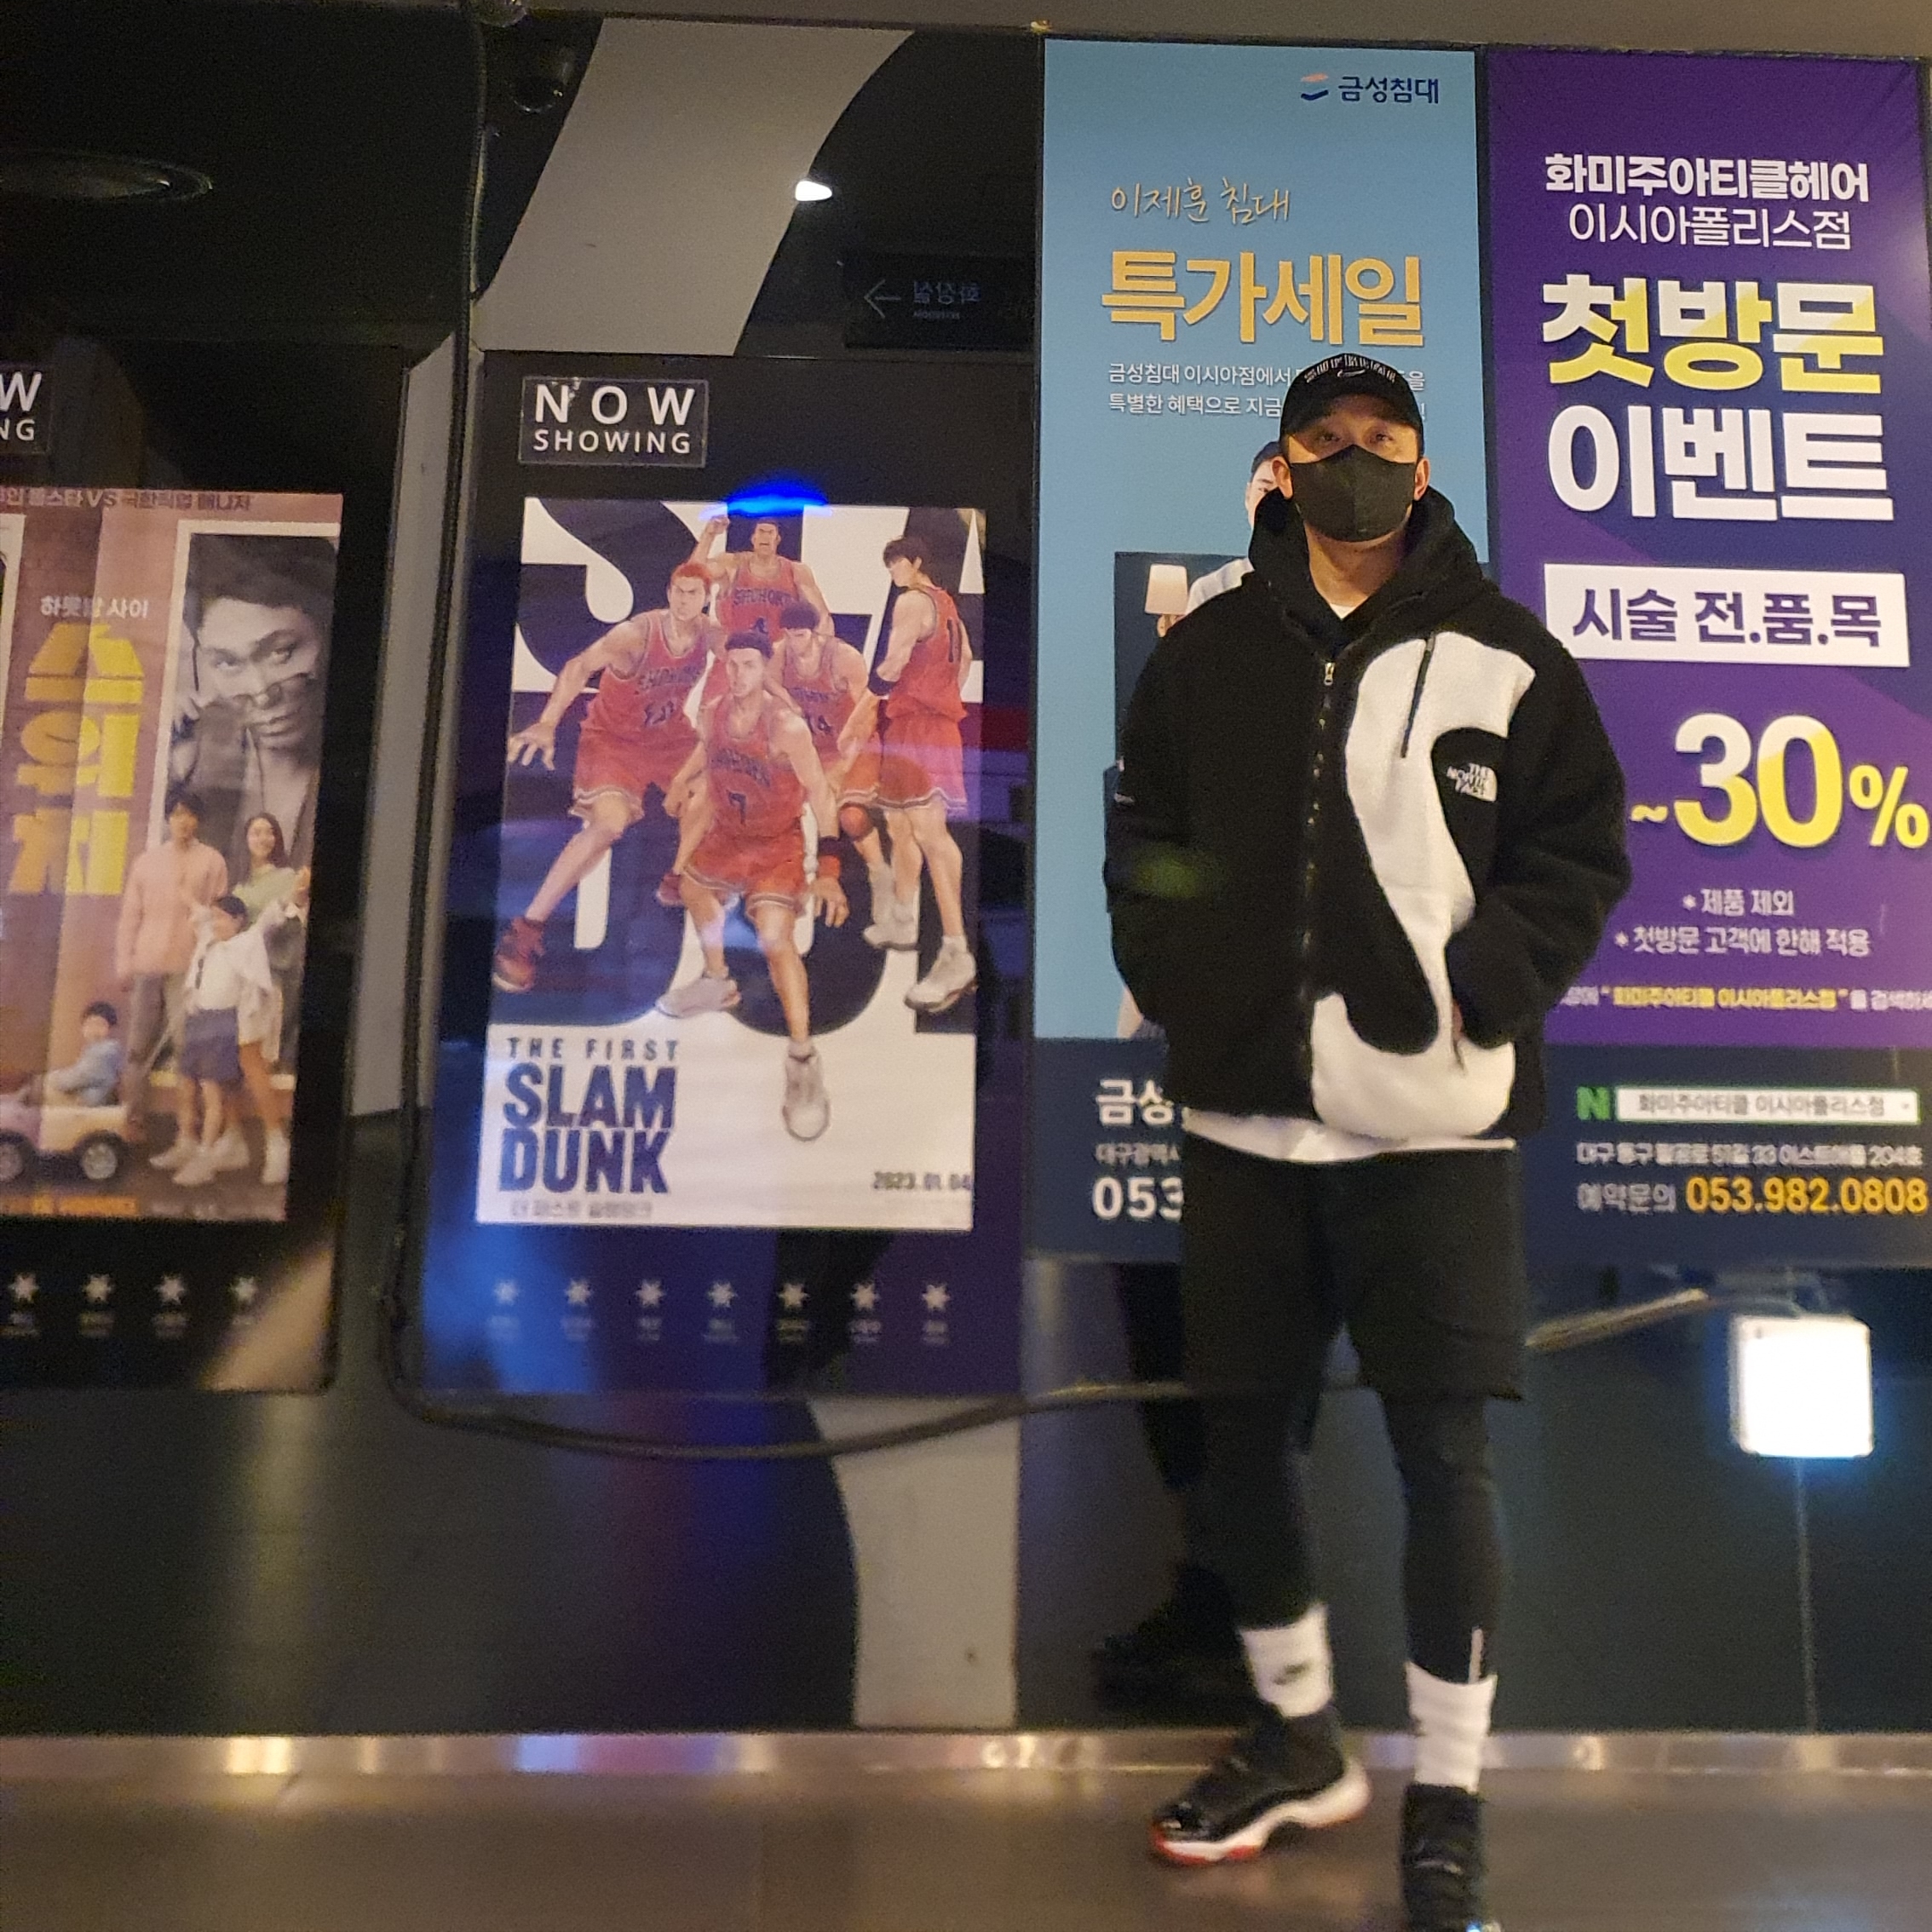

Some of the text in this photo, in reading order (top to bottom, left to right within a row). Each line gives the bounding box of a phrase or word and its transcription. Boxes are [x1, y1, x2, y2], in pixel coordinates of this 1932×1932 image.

[1338, 76, 1439, 104] 금성침대
[1545, 153, 1870, 202] 화미주아티클헤어
[1112, 176, 1291, 224] 이제훈 침대
[1569, 203, 1851, 250] 이시아폴리스점
[1101, 251, 1425, 346] 특가세일
[1543, 273, 1883, 394] 첫방문
[1108, 362, 1180, 383] 금성침대
[1183, 364, 1291, 387] 이시아점에서
[534, 384, 696, 426] NOW
[1108, 393, 1164, 413] 특별한
[1167, 394, 1241, 416] 혜택으로
[533, 429, 691, 454] SHOWING
[1548, 405, 1895, 520] 이벤트
[106, 597, 149, 618] 사이
[1573, 588, 1883, 647] 시술 전.품.목
[1700, 888, 1795, 917] 제품 제외
[1633, 925, 1872, 957] 첫방문 고객에 한해 적용
[506, 1037, 680, 1061] THE FIRST
[503, 1061, 677, 1129] SLAM
[499, 1127, 671, 1193] DUNK
[1686, 1176, 1929, 1215] 053.982.0808
